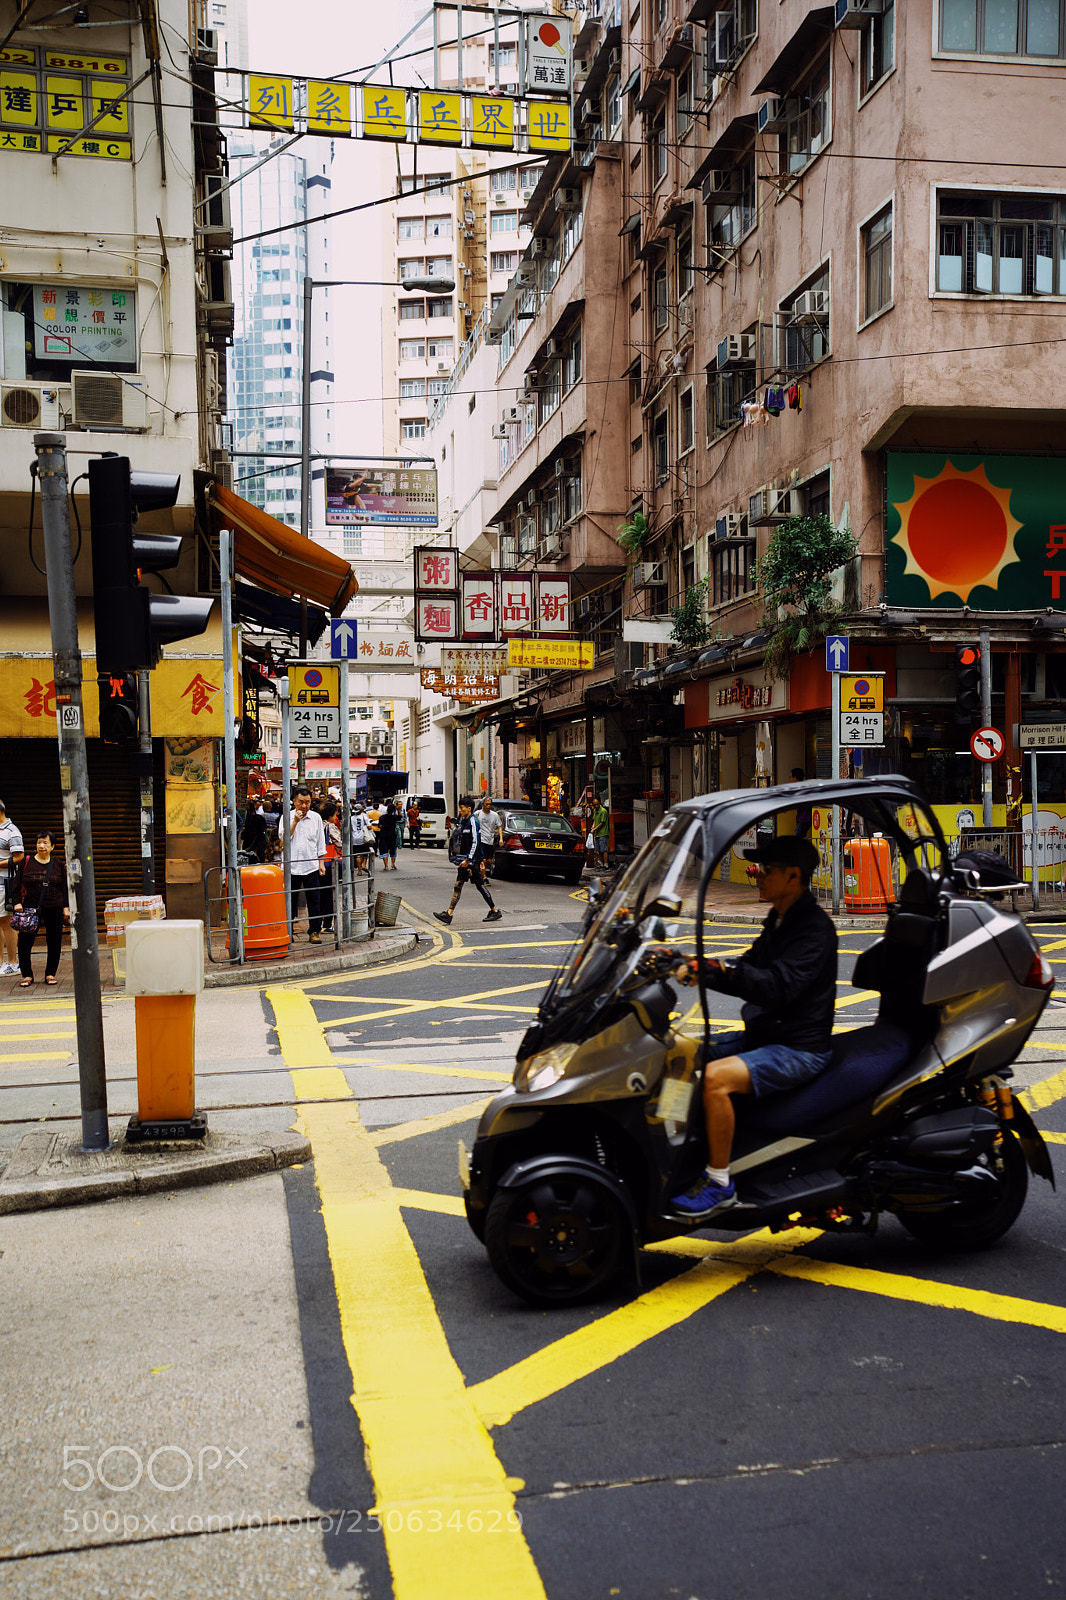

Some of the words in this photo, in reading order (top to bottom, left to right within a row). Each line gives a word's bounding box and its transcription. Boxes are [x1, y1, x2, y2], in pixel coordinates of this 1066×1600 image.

[49, 57, 121, 73] 8816
[533, 65, 567, 85] 萬達
[41, 289, 127, 309] 新景彩印
[46, 324, 77, 334] COLOR
[81, 326, 123, 337] PRINTING
[180, 672, 221, 716] 食
[293, 710, 311, 722] 24
[314, 710, 333, 722] hrs
[845, 716, 860, 726] 24
[862, 715, 879, 726] hrs
[298, 724, 329, 739] 全日
[848, 728, 875, 740] 全日
[1021, 726, 1051, 734] Morrison
[143, 1126, 186, 1137] 43598
